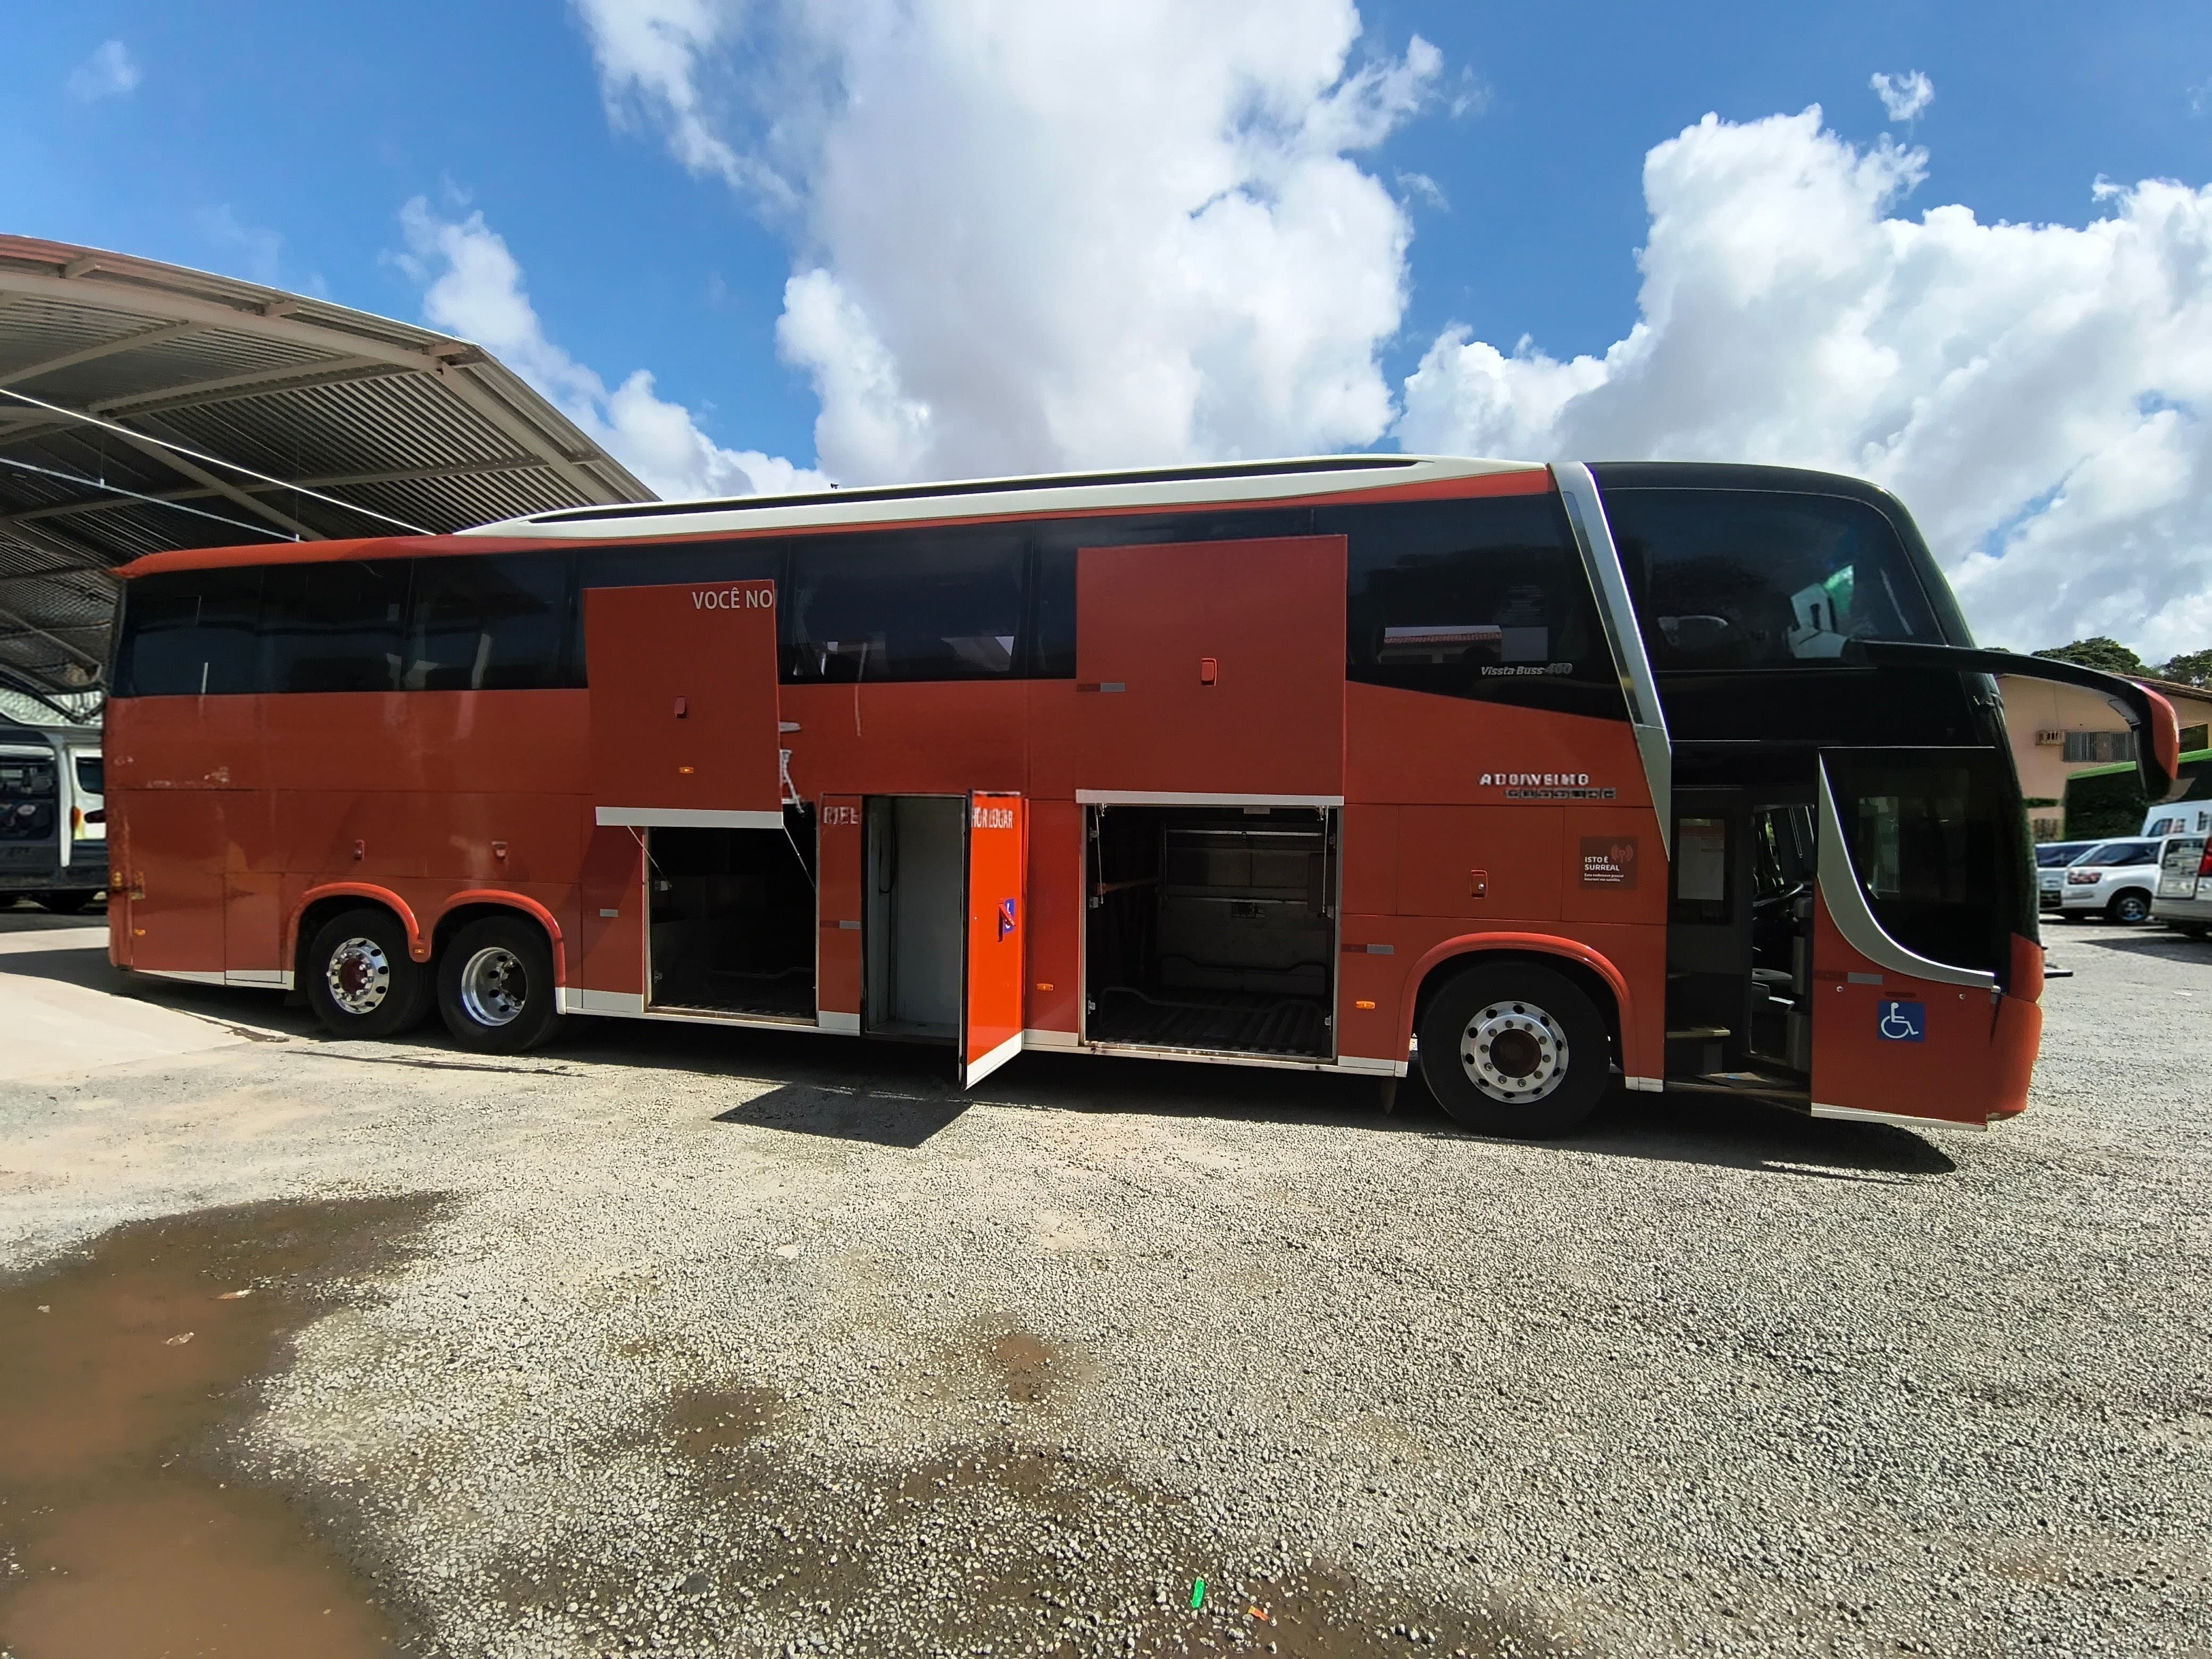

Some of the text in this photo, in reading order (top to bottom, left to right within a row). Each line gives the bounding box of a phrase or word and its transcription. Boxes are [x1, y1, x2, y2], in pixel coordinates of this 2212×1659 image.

[692, 587, 773, 609] VOCÊ NO
[1481, 666, 1515, 675] Vissta
[1516, 666, 1545, 675] Buss
[989, 808, 1012, 828] LUGAR
